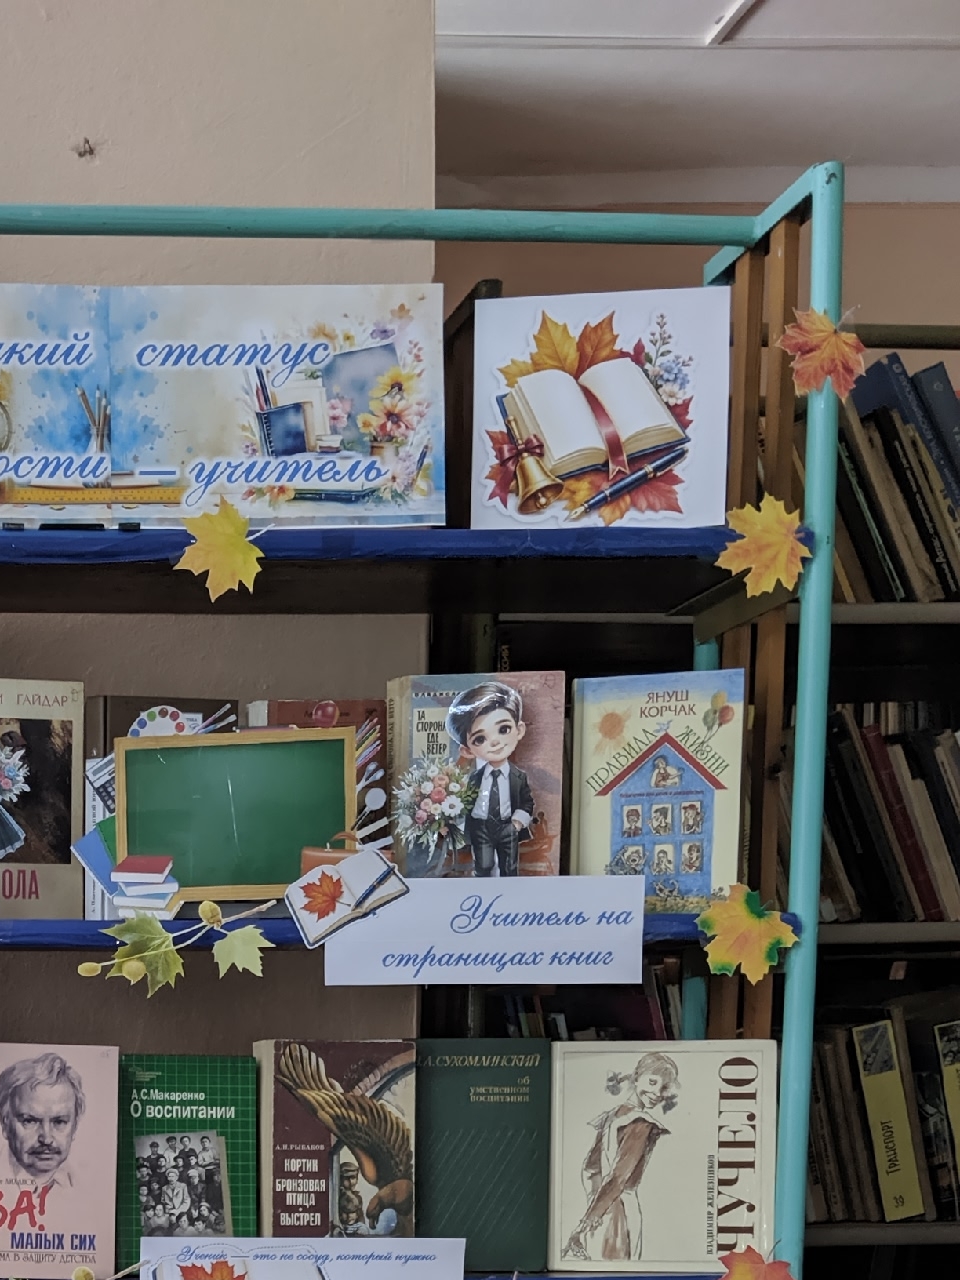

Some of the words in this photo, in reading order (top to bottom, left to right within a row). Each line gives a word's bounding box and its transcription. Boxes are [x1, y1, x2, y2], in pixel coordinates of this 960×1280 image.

[134, 339, 332, 388] статус
[180, 453, 391, 507] учитель
[16, 692, 68, 708] ГАЙДАР
[645, 689, 690, 705] ЯНУШ
[417, 710, 426, 720] ТА
[639, 702, 697, 719] КОРЧАК
[427, 732, 440, 743] ГДЕ
[426, 743, 448, 755] ВЕТЕР
[676, 725, 731, 777] ЖИЗНИ
[585, 727, 660, 792] ПРАВИЛА
[450, 893, 590, 934] Учитель
[597, 911, 634, 926] на
[381, 944, 545, 978] страницах
[549, 947, 614, 966] книг
[517, 1076, 530, 1085] об
[469, 1086, 530, 1096] умственном
[130, 1100, 142, 1118] О
[145, 1104, 236, 1119] воспитании
[716, 1056, 760, 1256] ЧУЧЕЛО
[284, 1158, 319, 1172] КОРТИК
[275, 1178, 326, 1192] БРОНЗОВАЯ
[707, 1154, 716, 1203] ЖЕЛЕЗНИКОВ
[285, 1191, 316, 1207] ПТИЦА
[279, 1212, 322, 1226] ВЫСТРЕЛ
[706, 1207, 715, 1255] ВЛАДИМИР
[9, 1232, 65, 1250] МАЛЫХ
[70, 1233, 97, 1251] СИХ
[13, 1253, 20, 1262] В
[21, 1252, 58, 1264] ЗАЩИТУ
[58, 1252, 97, 1265] ДЕТСТВА
[177, 1246, 228, 1263] Ученик
[252, 1253, 277, 1261] это
[279, 1253, 294, 1261] не
[335, 1252, 392, 1264] который
[394, 1253, 437, 1264] нужно
